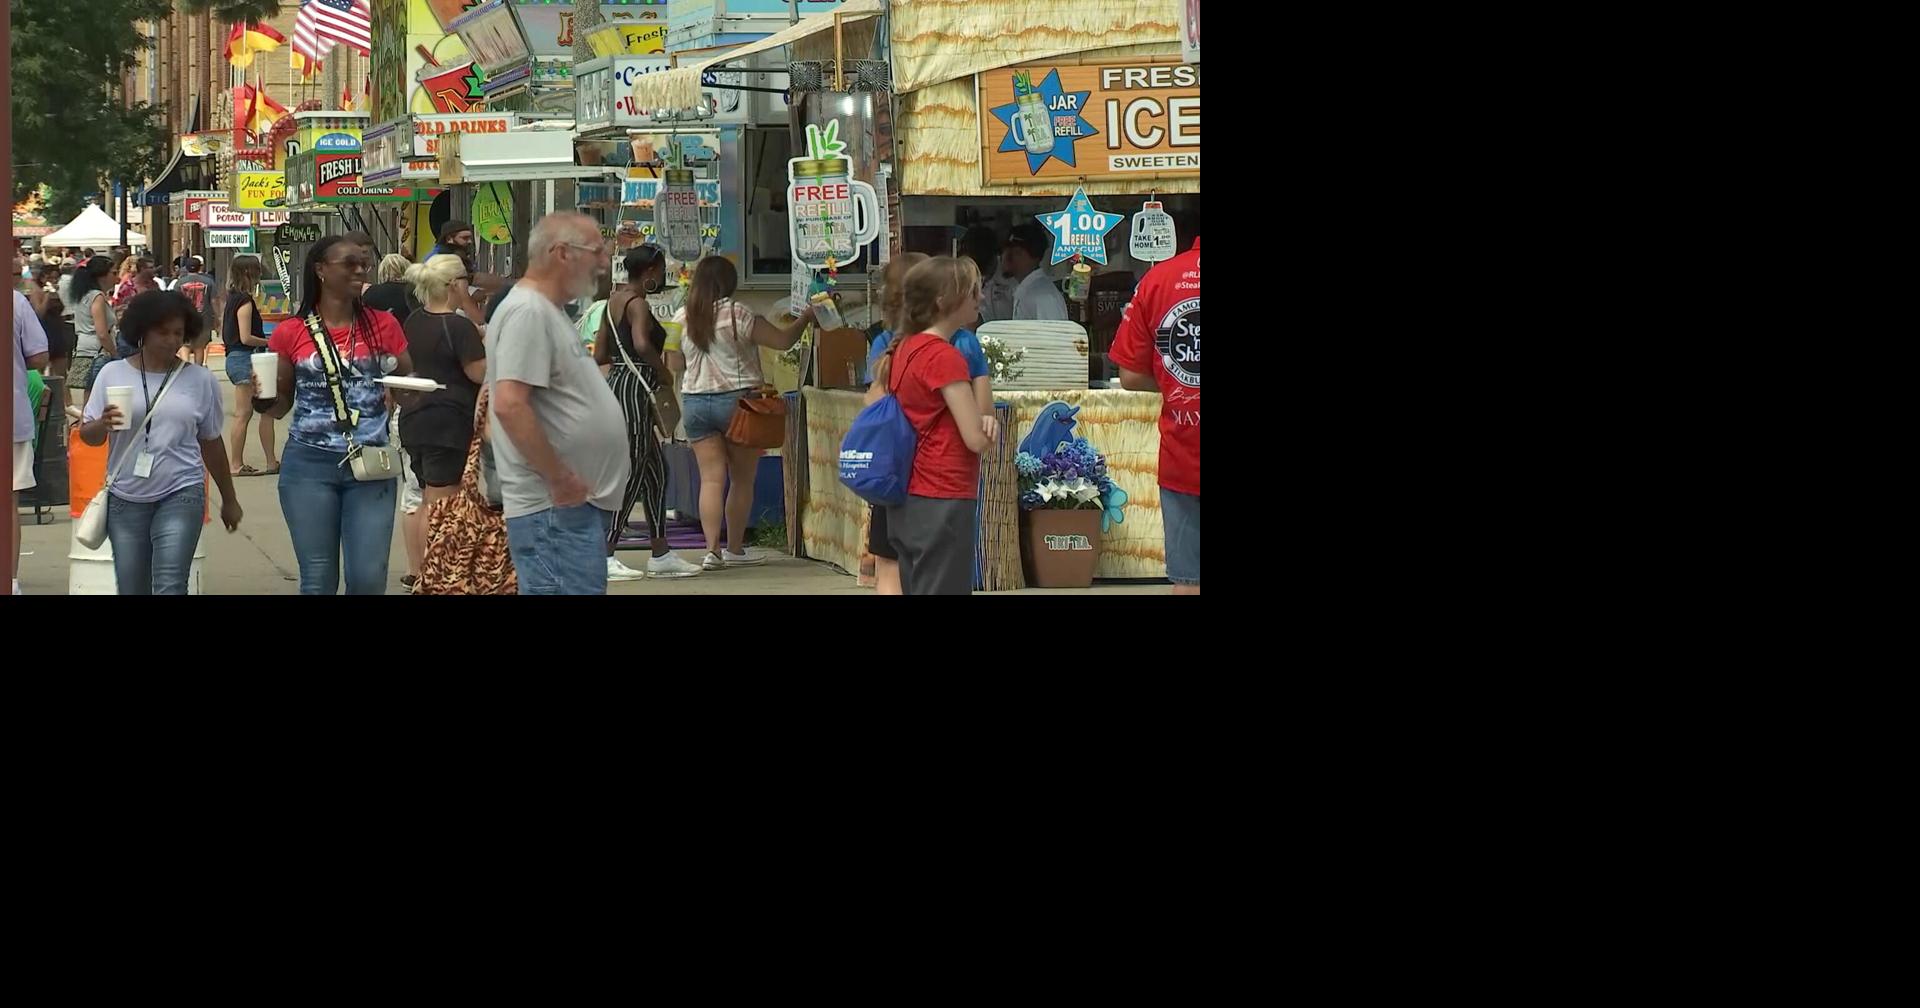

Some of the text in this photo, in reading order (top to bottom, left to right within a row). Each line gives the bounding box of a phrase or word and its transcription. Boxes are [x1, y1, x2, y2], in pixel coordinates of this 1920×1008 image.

[1103, 66, 1200, 89] FRES
[1049, 95, 1078, 110] JAR
[414, 120, 507, 136] OLD DRINKS
[1054, 116, 1076, 126] FREE
[1054, 126, 1083, 136] REFILL
[1113, 156, 1198, 168] SWEETEN
[320, 158, 352, 184] FRESH
[242, 176, 270, 190] Jack's
[338, 186, 360, 194] COLD
[248, 190, 265, 198] FUN
[666, 192, 696, 206] FREE
[794, 184, 848, 202] FREE
[795, 202, 852, 217] REFILL
[210, 234, 248, 244] COOKIE SHOT
[281, 224, 315, 242] LEMONADE
[1071, 234, 1100, 246] REFILLS
[799, 238, 852, 250] JAR
[1172, 300, 1200, 318] FAMO
